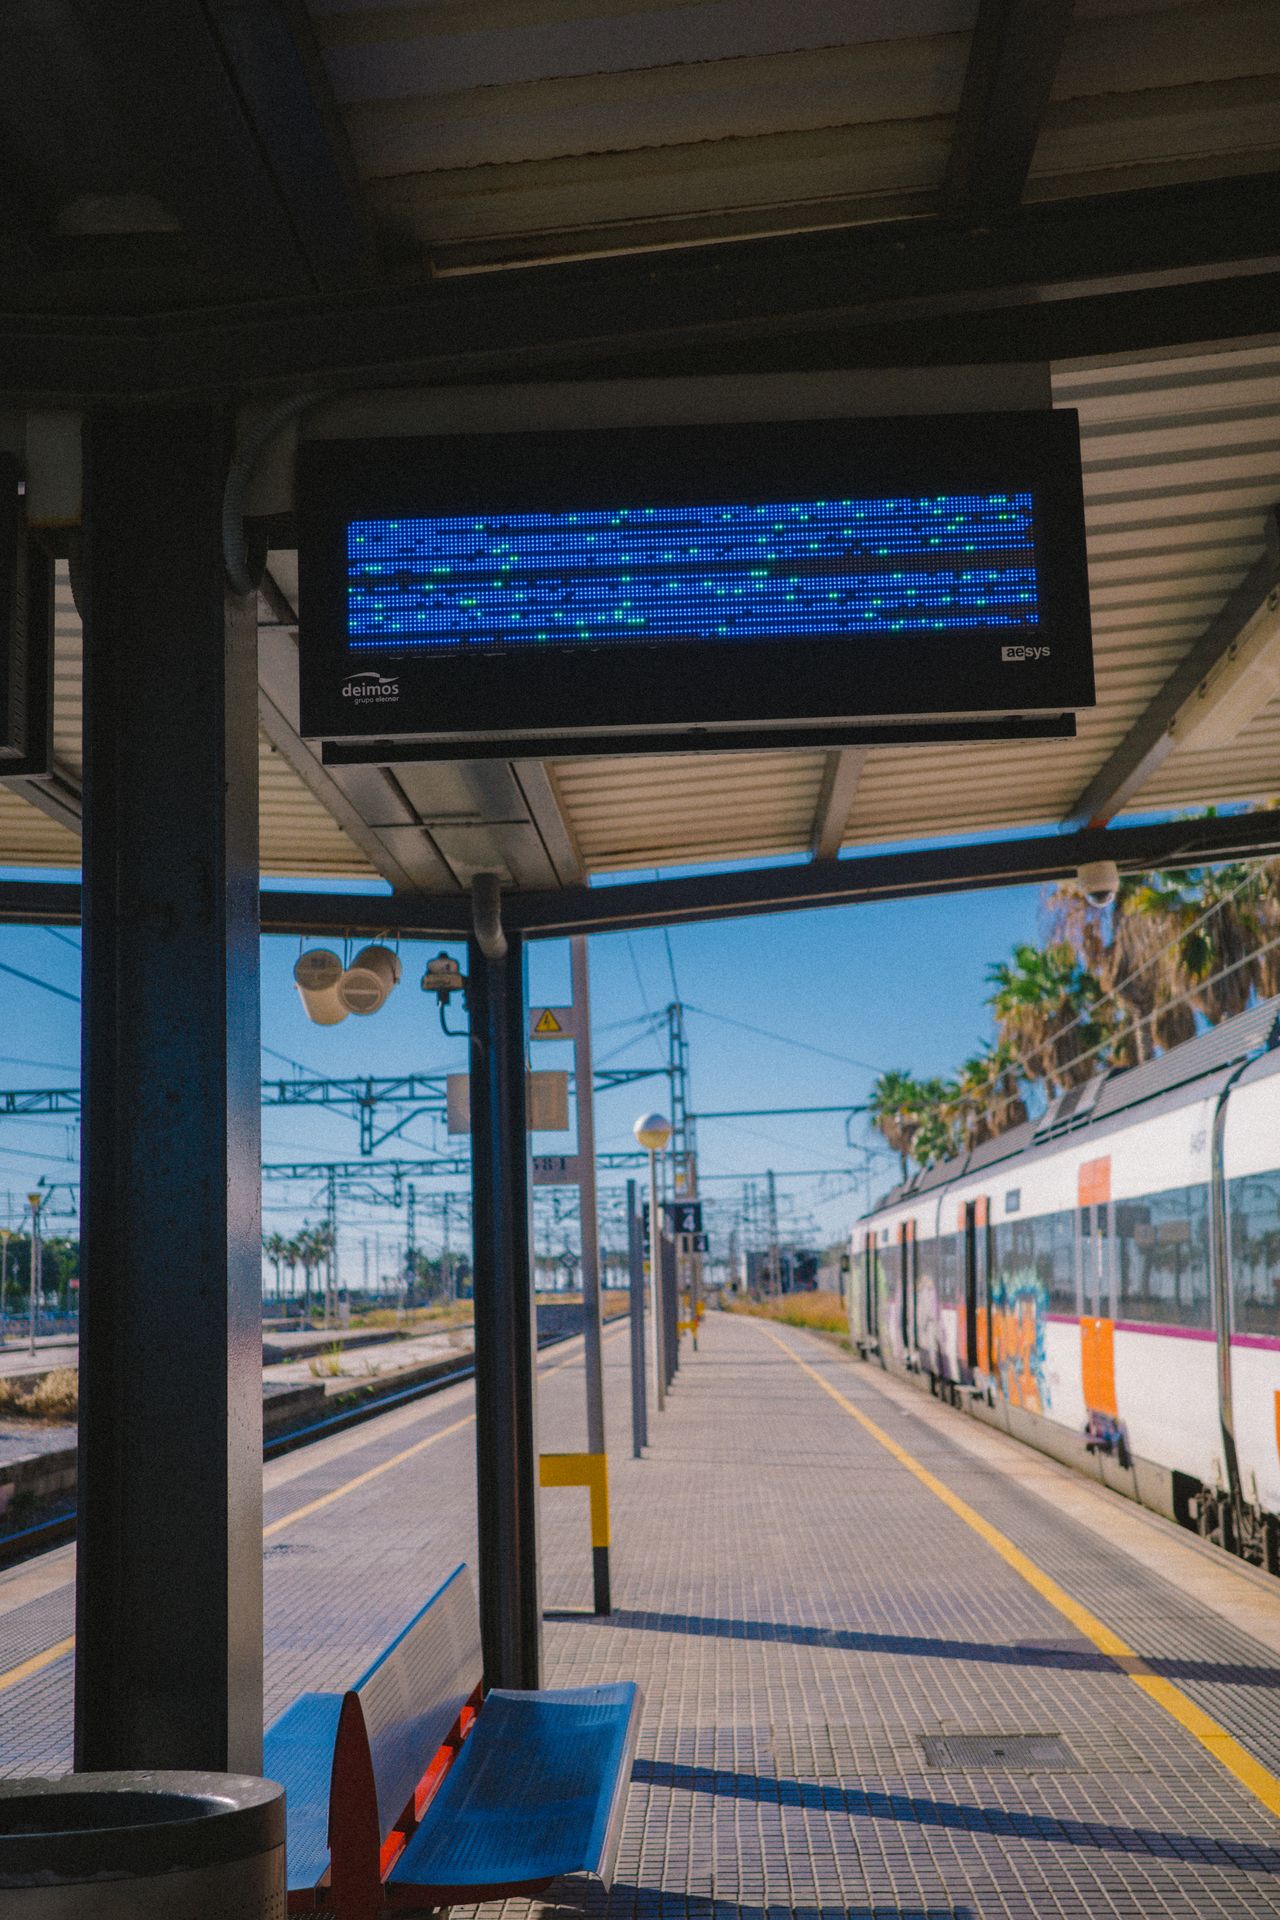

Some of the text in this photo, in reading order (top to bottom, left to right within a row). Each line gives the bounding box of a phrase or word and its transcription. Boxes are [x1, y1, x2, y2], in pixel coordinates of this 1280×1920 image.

[1007, 646, 1051, 660] aesys
[342, 682, 399, 697] deimos
[354, 697, 374, 706] grupo
